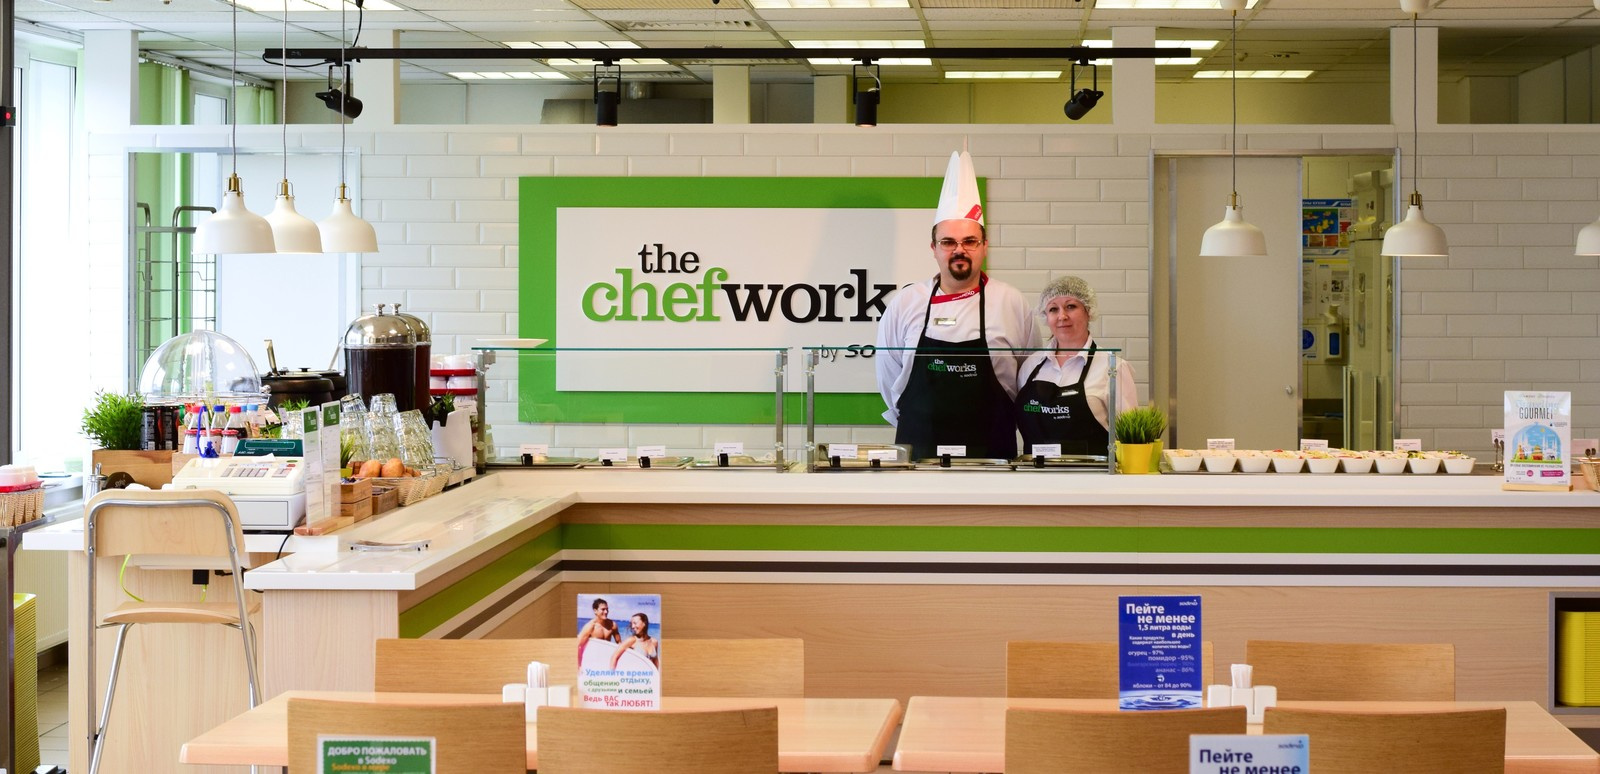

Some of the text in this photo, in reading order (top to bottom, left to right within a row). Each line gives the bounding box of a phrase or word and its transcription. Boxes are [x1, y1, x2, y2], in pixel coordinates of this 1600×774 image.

[638, 243, 700, 274] the
[582, 267, 914, 323] chefwork
[821, 344, 838, 363] by
[1029, 398, 1040, 406] the
[1126, 603, 1165, 614] Пейте
[1137, 615, 1196, 624] не менее
[585, 669, 653, 678] Уделяйте время
[583, 679, 620, 687] общению
[620, 677, 651, 685] отдыху,
[620, 699, 653, 707] ЛЮБЯТ!
[328, 746, 427, 757] ДОБРО ПОЖАЛОВАТЬ
[1200, 749, 1253, 763] Пейте
[365, 756, 397, 765] Sodexo
[1220, 765, 1301, 774] не менее
